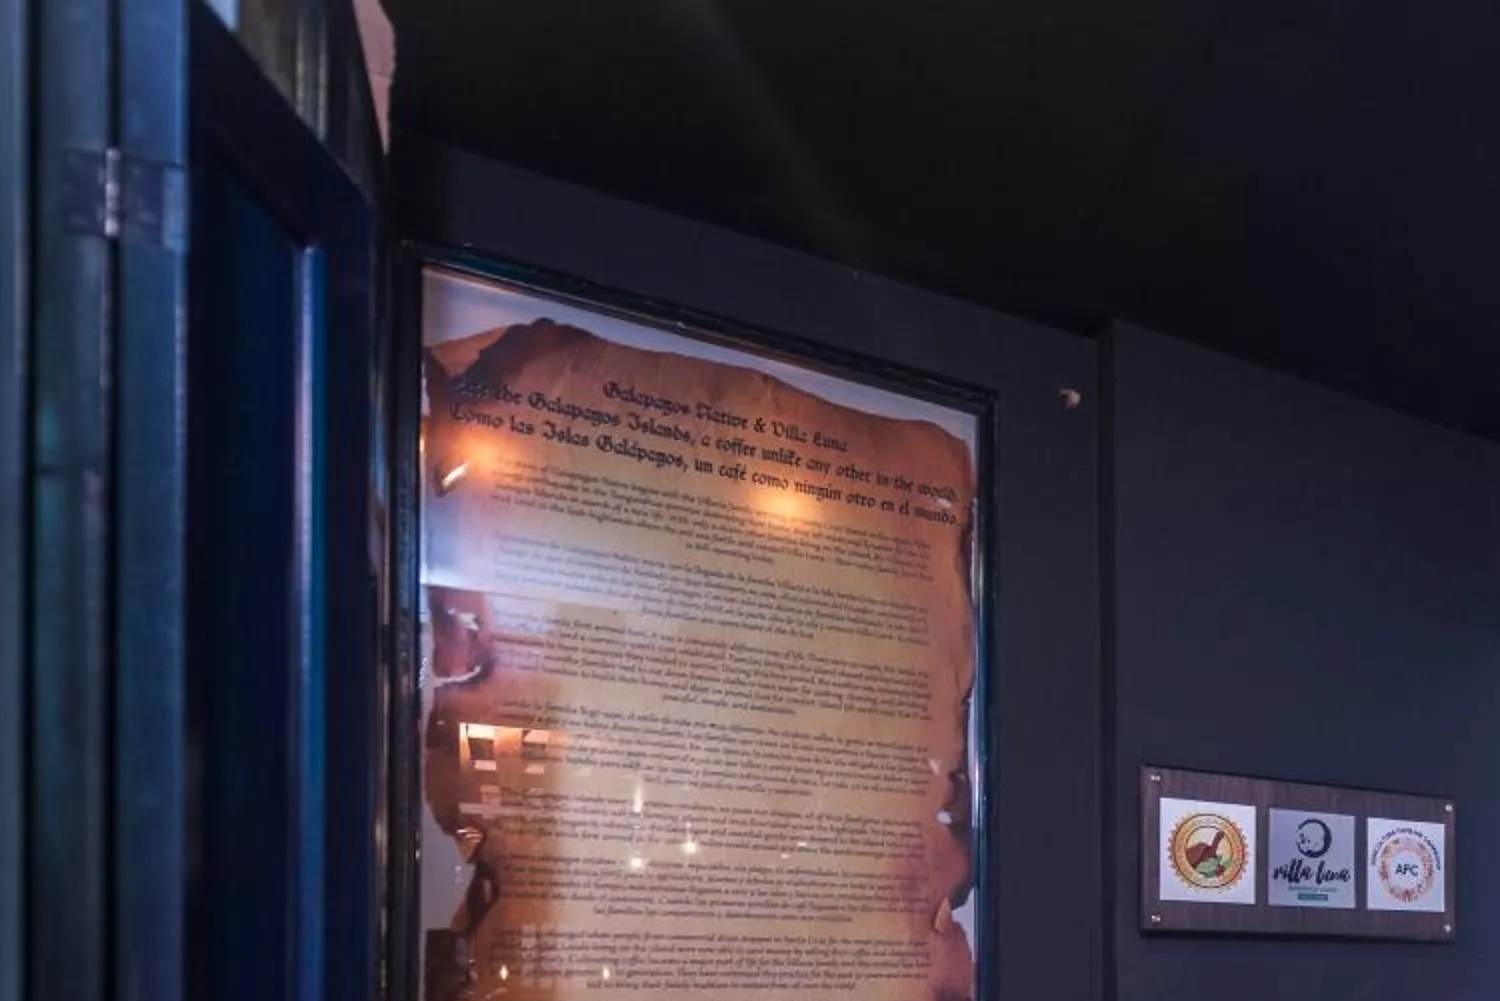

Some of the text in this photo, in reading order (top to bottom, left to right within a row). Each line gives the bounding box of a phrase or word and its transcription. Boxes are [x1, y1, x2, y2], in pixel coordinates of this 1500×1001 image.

[528, 391, 621, 427] Galapagos
[628, 411, 695, 446] Islands,
[701, 436, 710, 447] a
[715, 437, 757, 459] coffee
[806, 458, 831, 477] any
[835, 463, 871, 483] other
[603, 380, 691, 417] Galapagos
[696, 401, 750, 431] Native
[753, 417, 767, 433] &
[812, 430, 849, 453] Luna
[510, 414, 535, 435] las
[543, 420, 590, 447] Islas
[695, 458, 713, 474] un
[719, 463, 747, 485] café
[751, 471, 789, 490] como
[846, 491, 876, 508] otro
[898, 501, 910, 516] el
[1394, 863, 1419, 877] AFC
